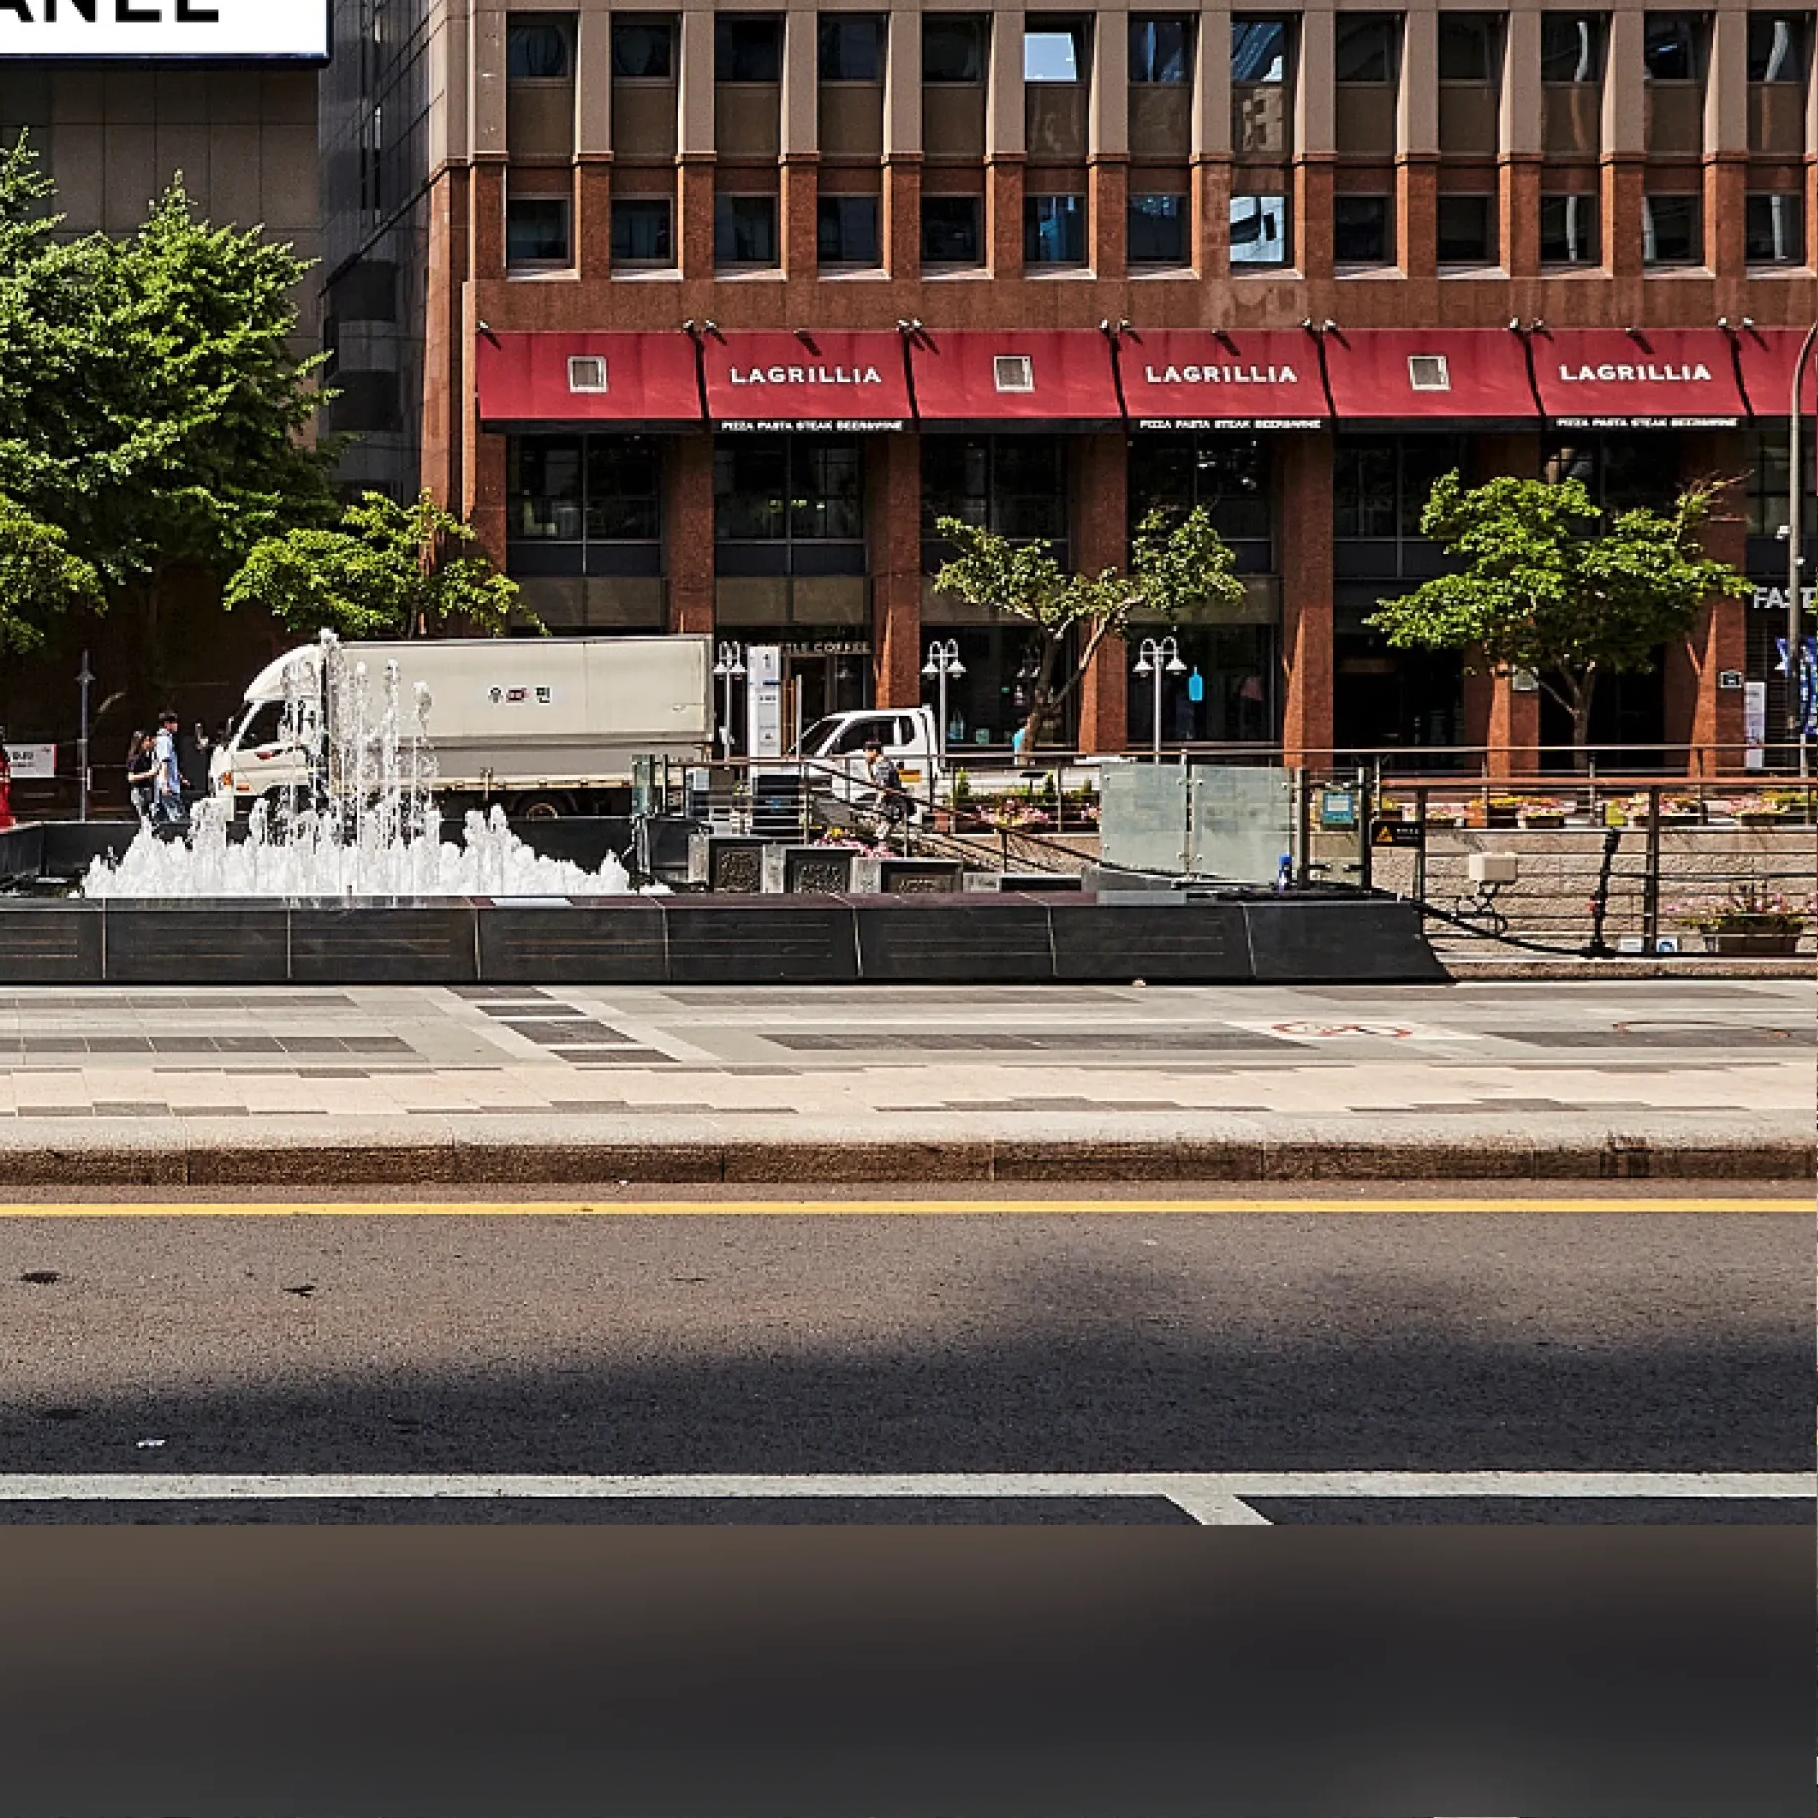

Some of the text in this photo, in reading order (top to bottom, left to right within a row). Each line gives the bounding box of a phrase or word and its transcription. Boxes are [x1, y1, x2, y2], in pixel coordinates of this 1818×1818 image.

[729, 366, 882, 383] LAGRILLIA
[1146, 365, 1298, 383] LAGRILLIA
[1559, 363, 1712, 381] LAGRILLIA
